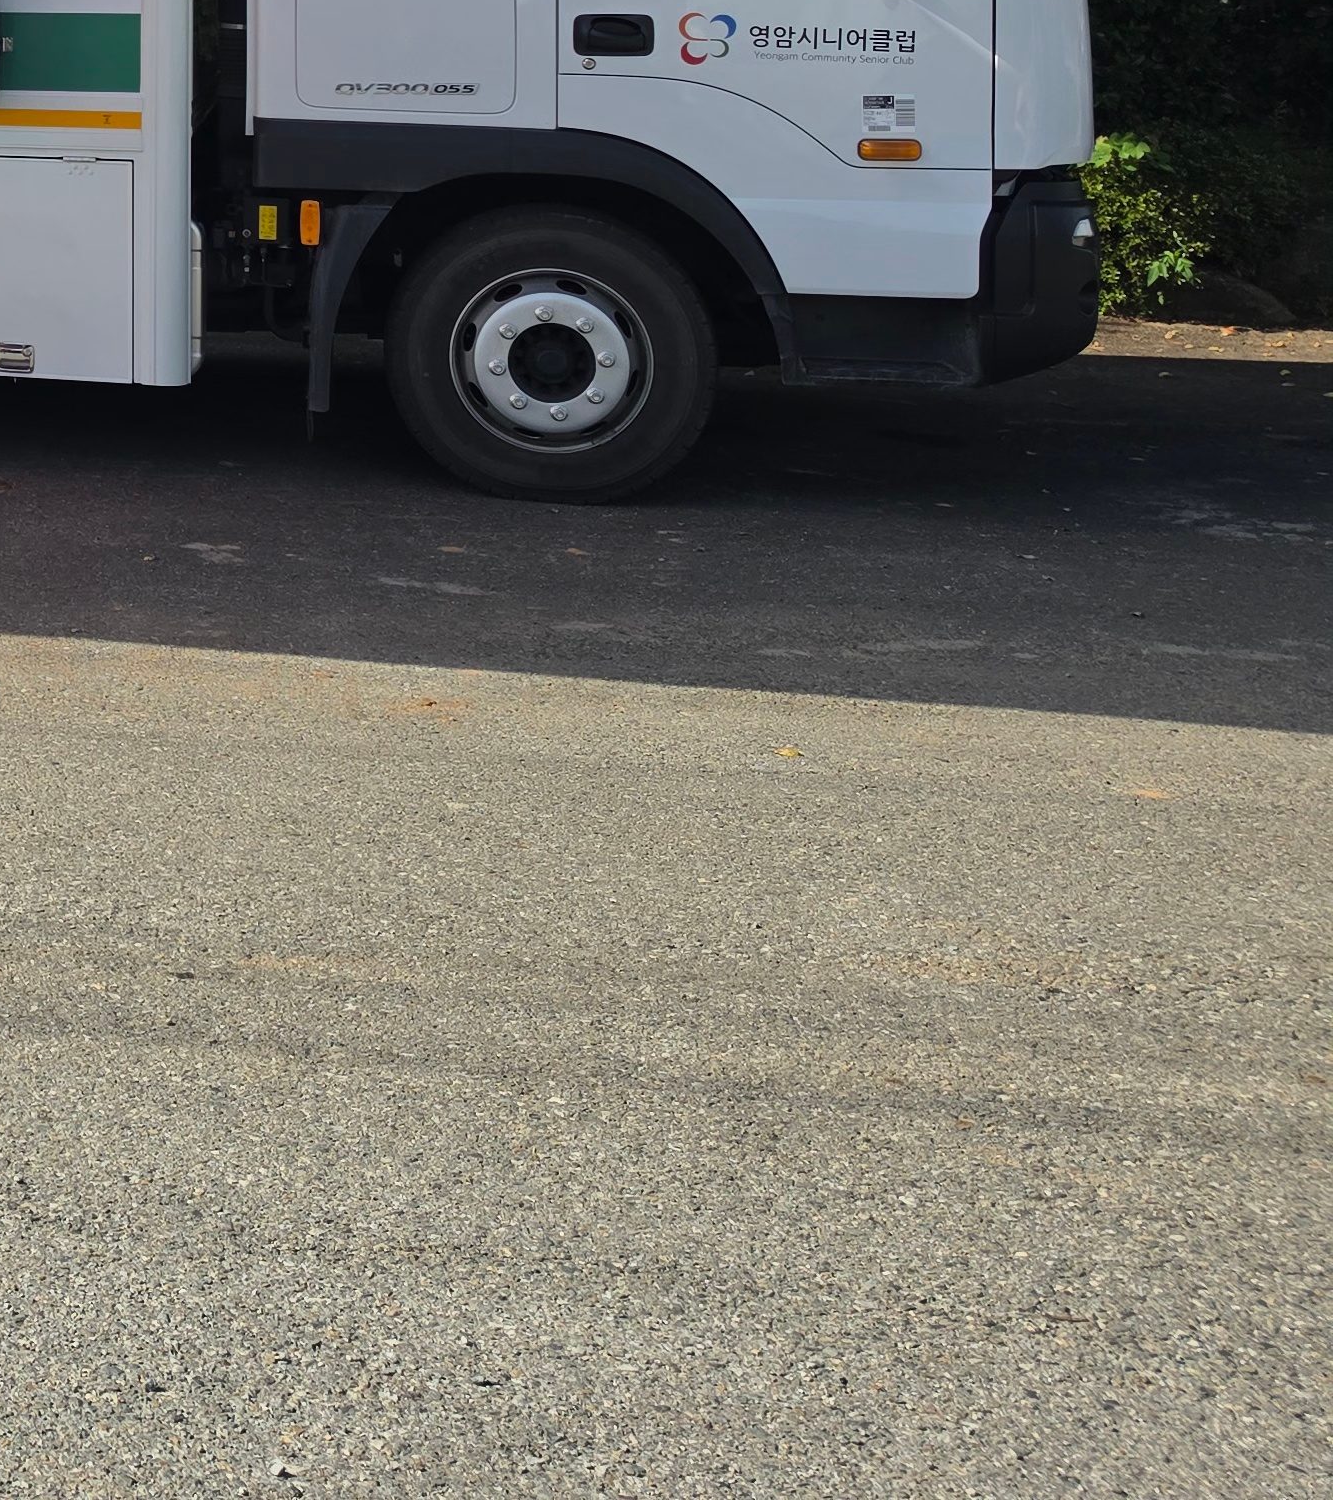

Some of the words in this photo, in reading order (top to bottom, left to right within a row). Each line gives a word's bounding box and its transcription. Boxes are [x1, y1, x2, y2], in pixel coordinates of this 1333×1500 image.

[749, 25, 916, 53] 영암시니어클럽
[753, 51, 799, 62] Yeongam
[801, 52, 856, 64] Community
[859, 54, 890, 64] Senior
[892, 55, 915, 65] Club
